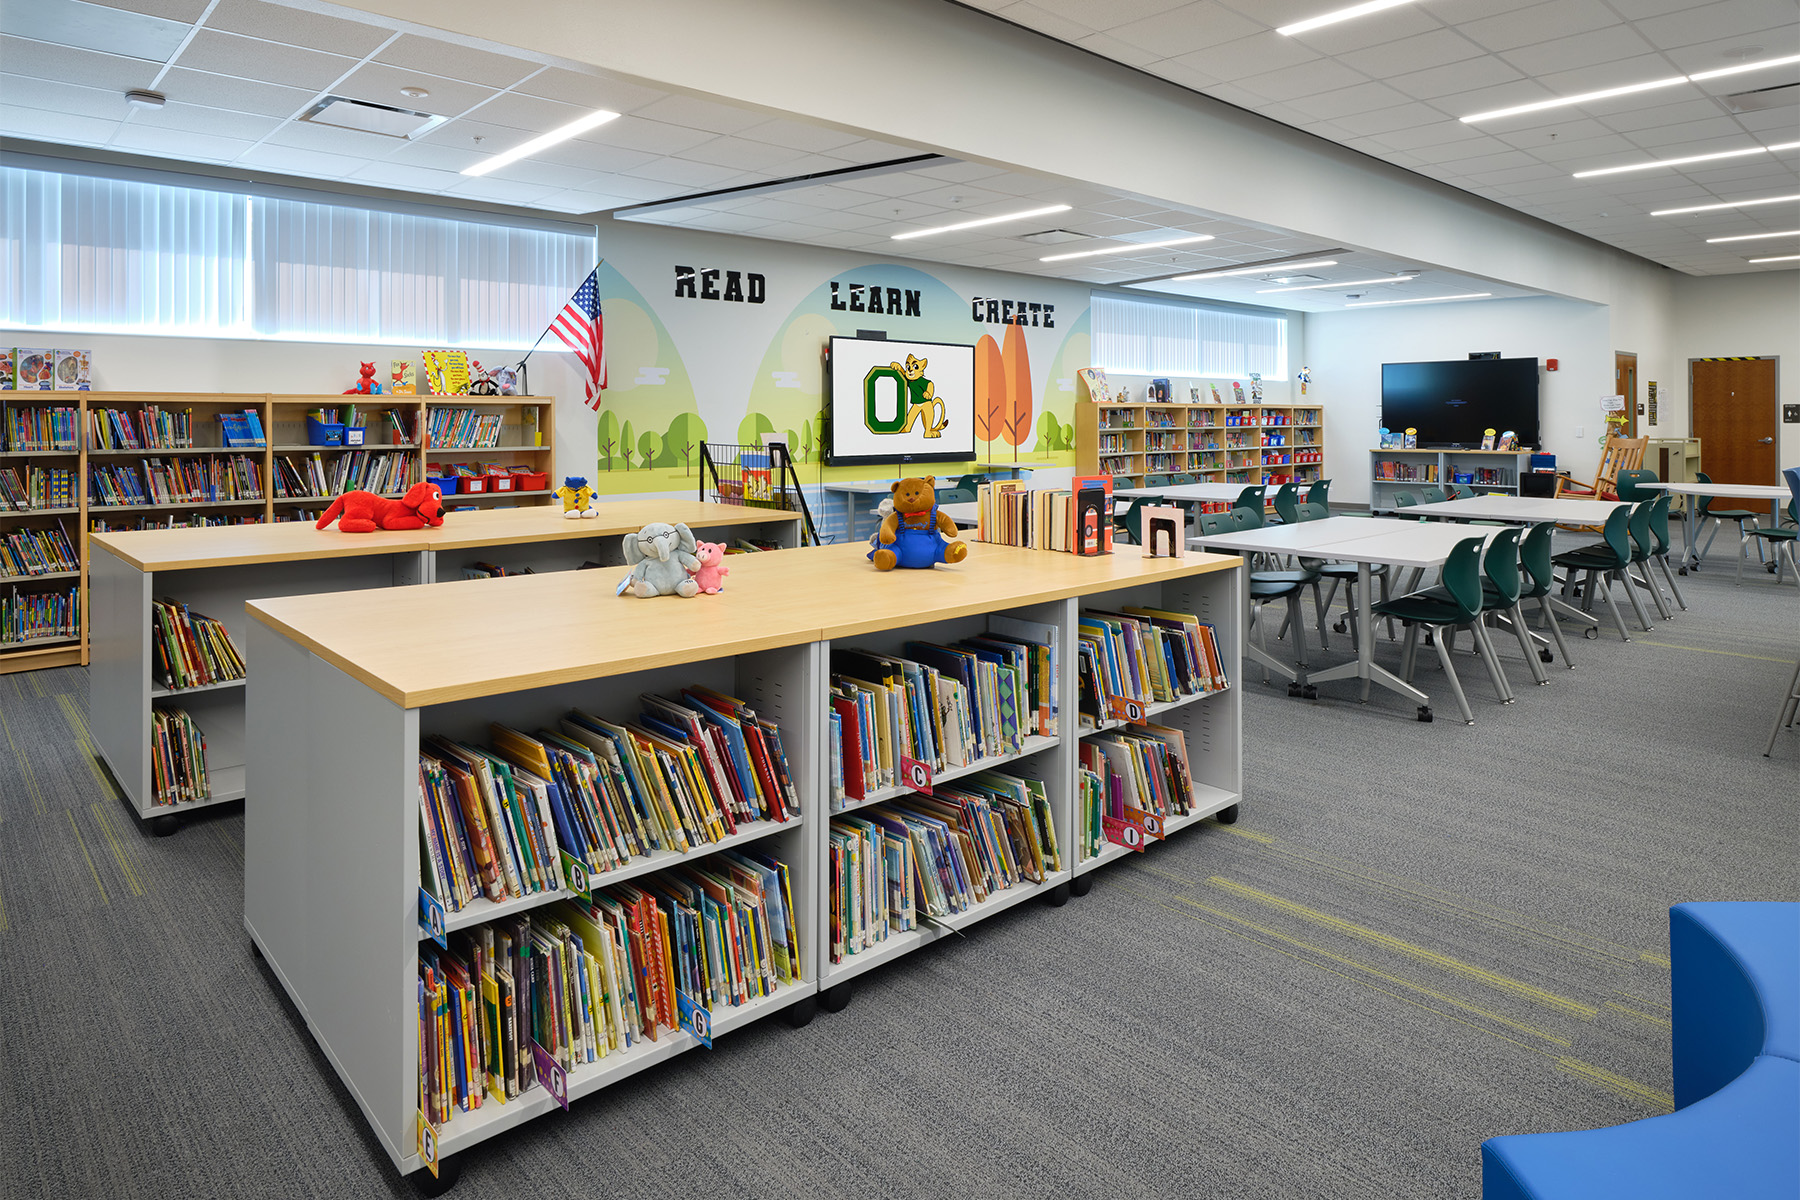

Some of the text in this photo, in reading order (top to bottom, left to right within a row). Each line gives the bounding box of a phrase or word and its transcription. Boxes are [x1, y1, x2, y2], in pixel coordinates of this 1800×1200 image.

[675, 265, 765, 304] READ
[830, 281, 921, 317] LEARN
[972, 297, 1055, 328] CREATE
[864, 366, 907, 434] O
[1130, 706, 1137, 718] D
[761, 756, 771, 783] JOURNEY
[914, 768, 922, 785] C
[1130, 832, 1133, 843] I
[1148, 820, 1155, 831] J
[574, 865, 582, 888] B
[432, 908, 439, 930] A
[696, 1010, 703, 1035] G
[554, 1070, 561, 1094] F
[425, 1130, 432, 1158] E
